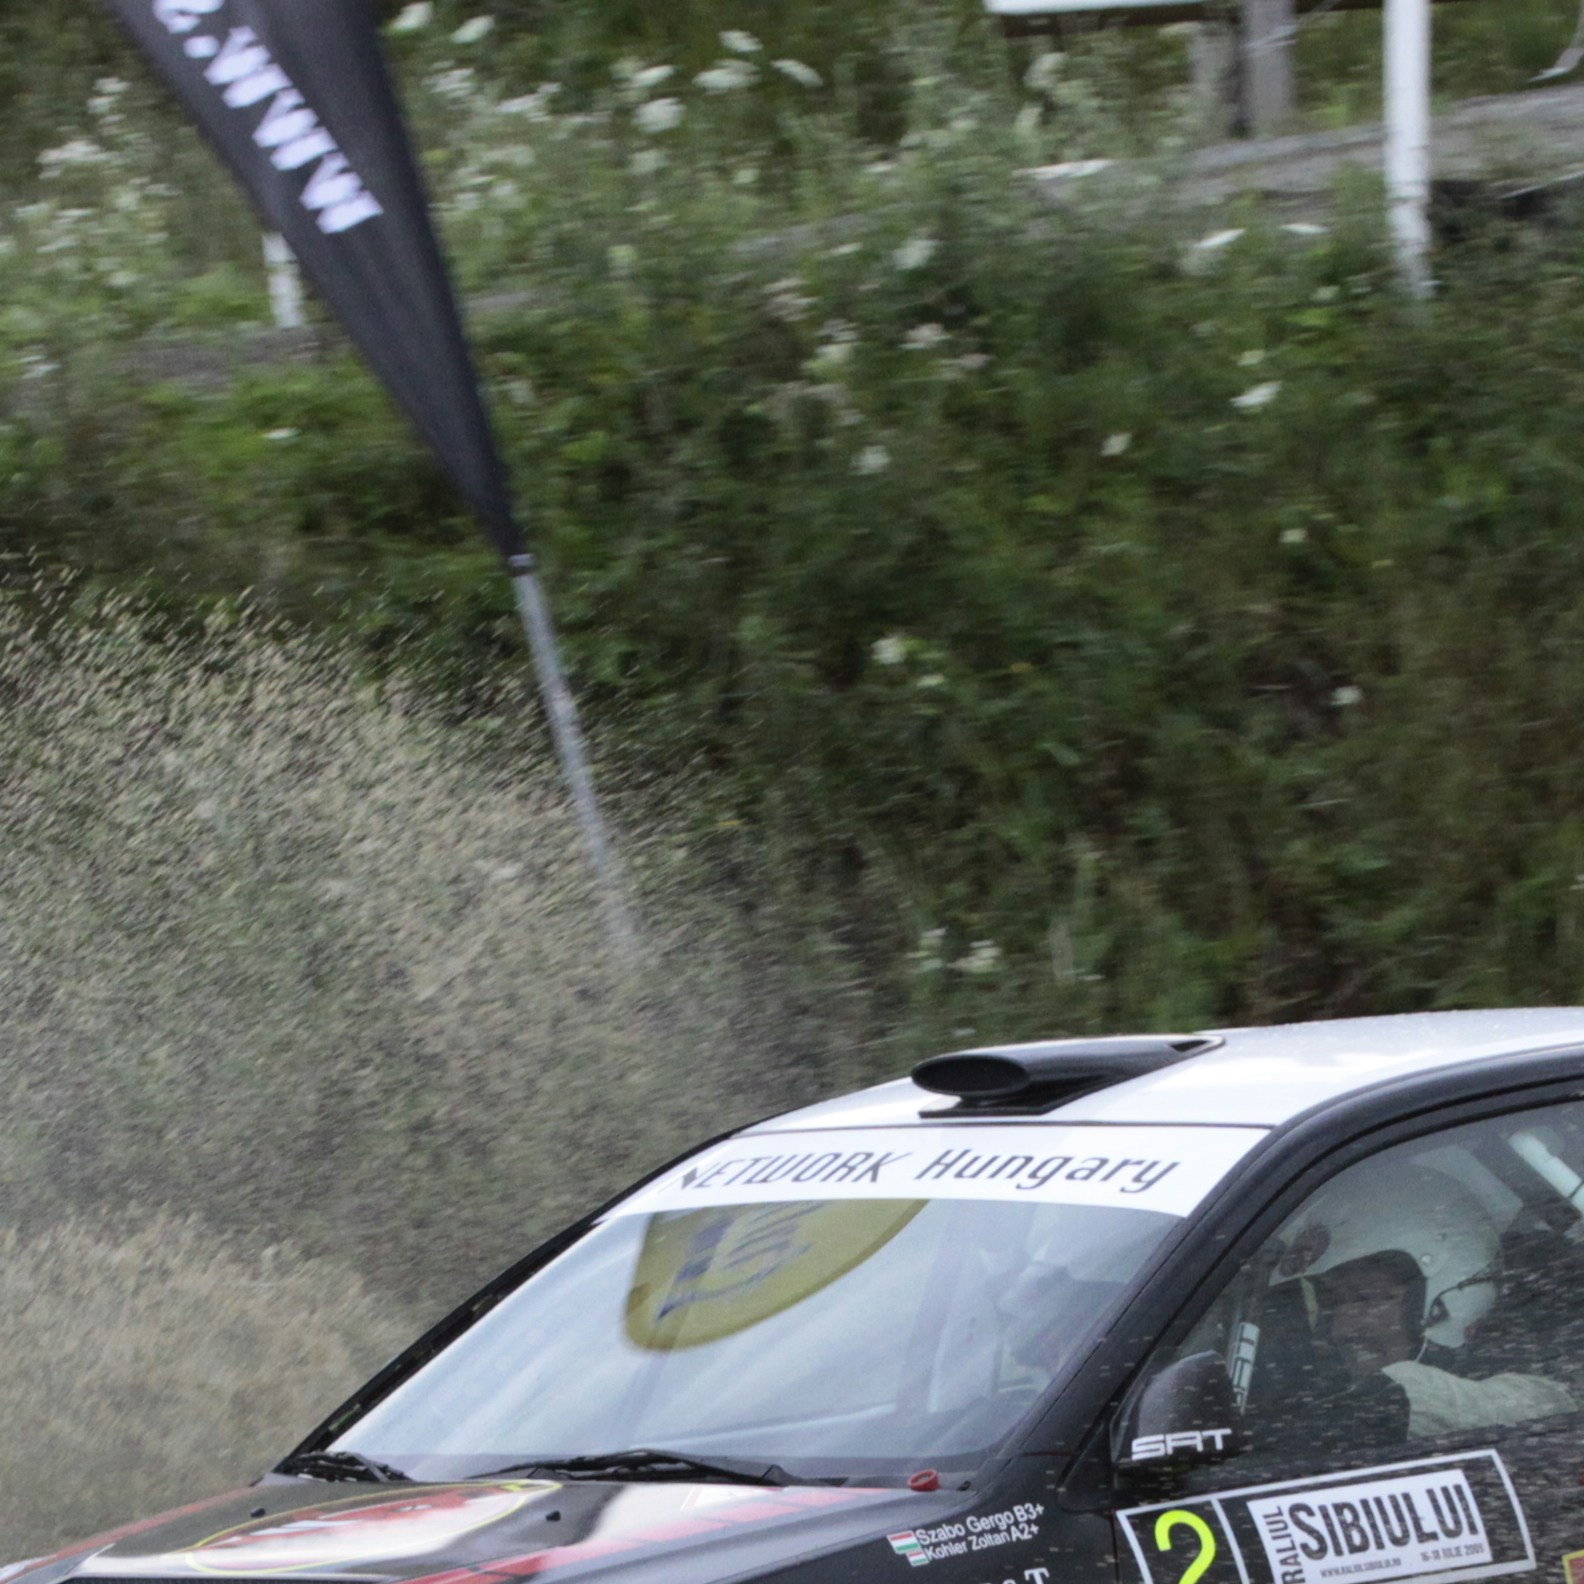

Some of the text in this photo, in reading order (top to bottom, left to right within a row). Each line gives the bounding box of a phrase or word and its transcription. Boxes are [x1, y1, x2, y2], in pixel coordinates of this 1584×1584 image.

[914, 1149, 1181, 1194] Hungary
[916, 1502, 1045, 1546] Szabo Gergo B3+
[924, 1523, 1040, 1561] Kohler Zoltan A2+
[1288, 1483, 1480, 1561] SIBIULUI
